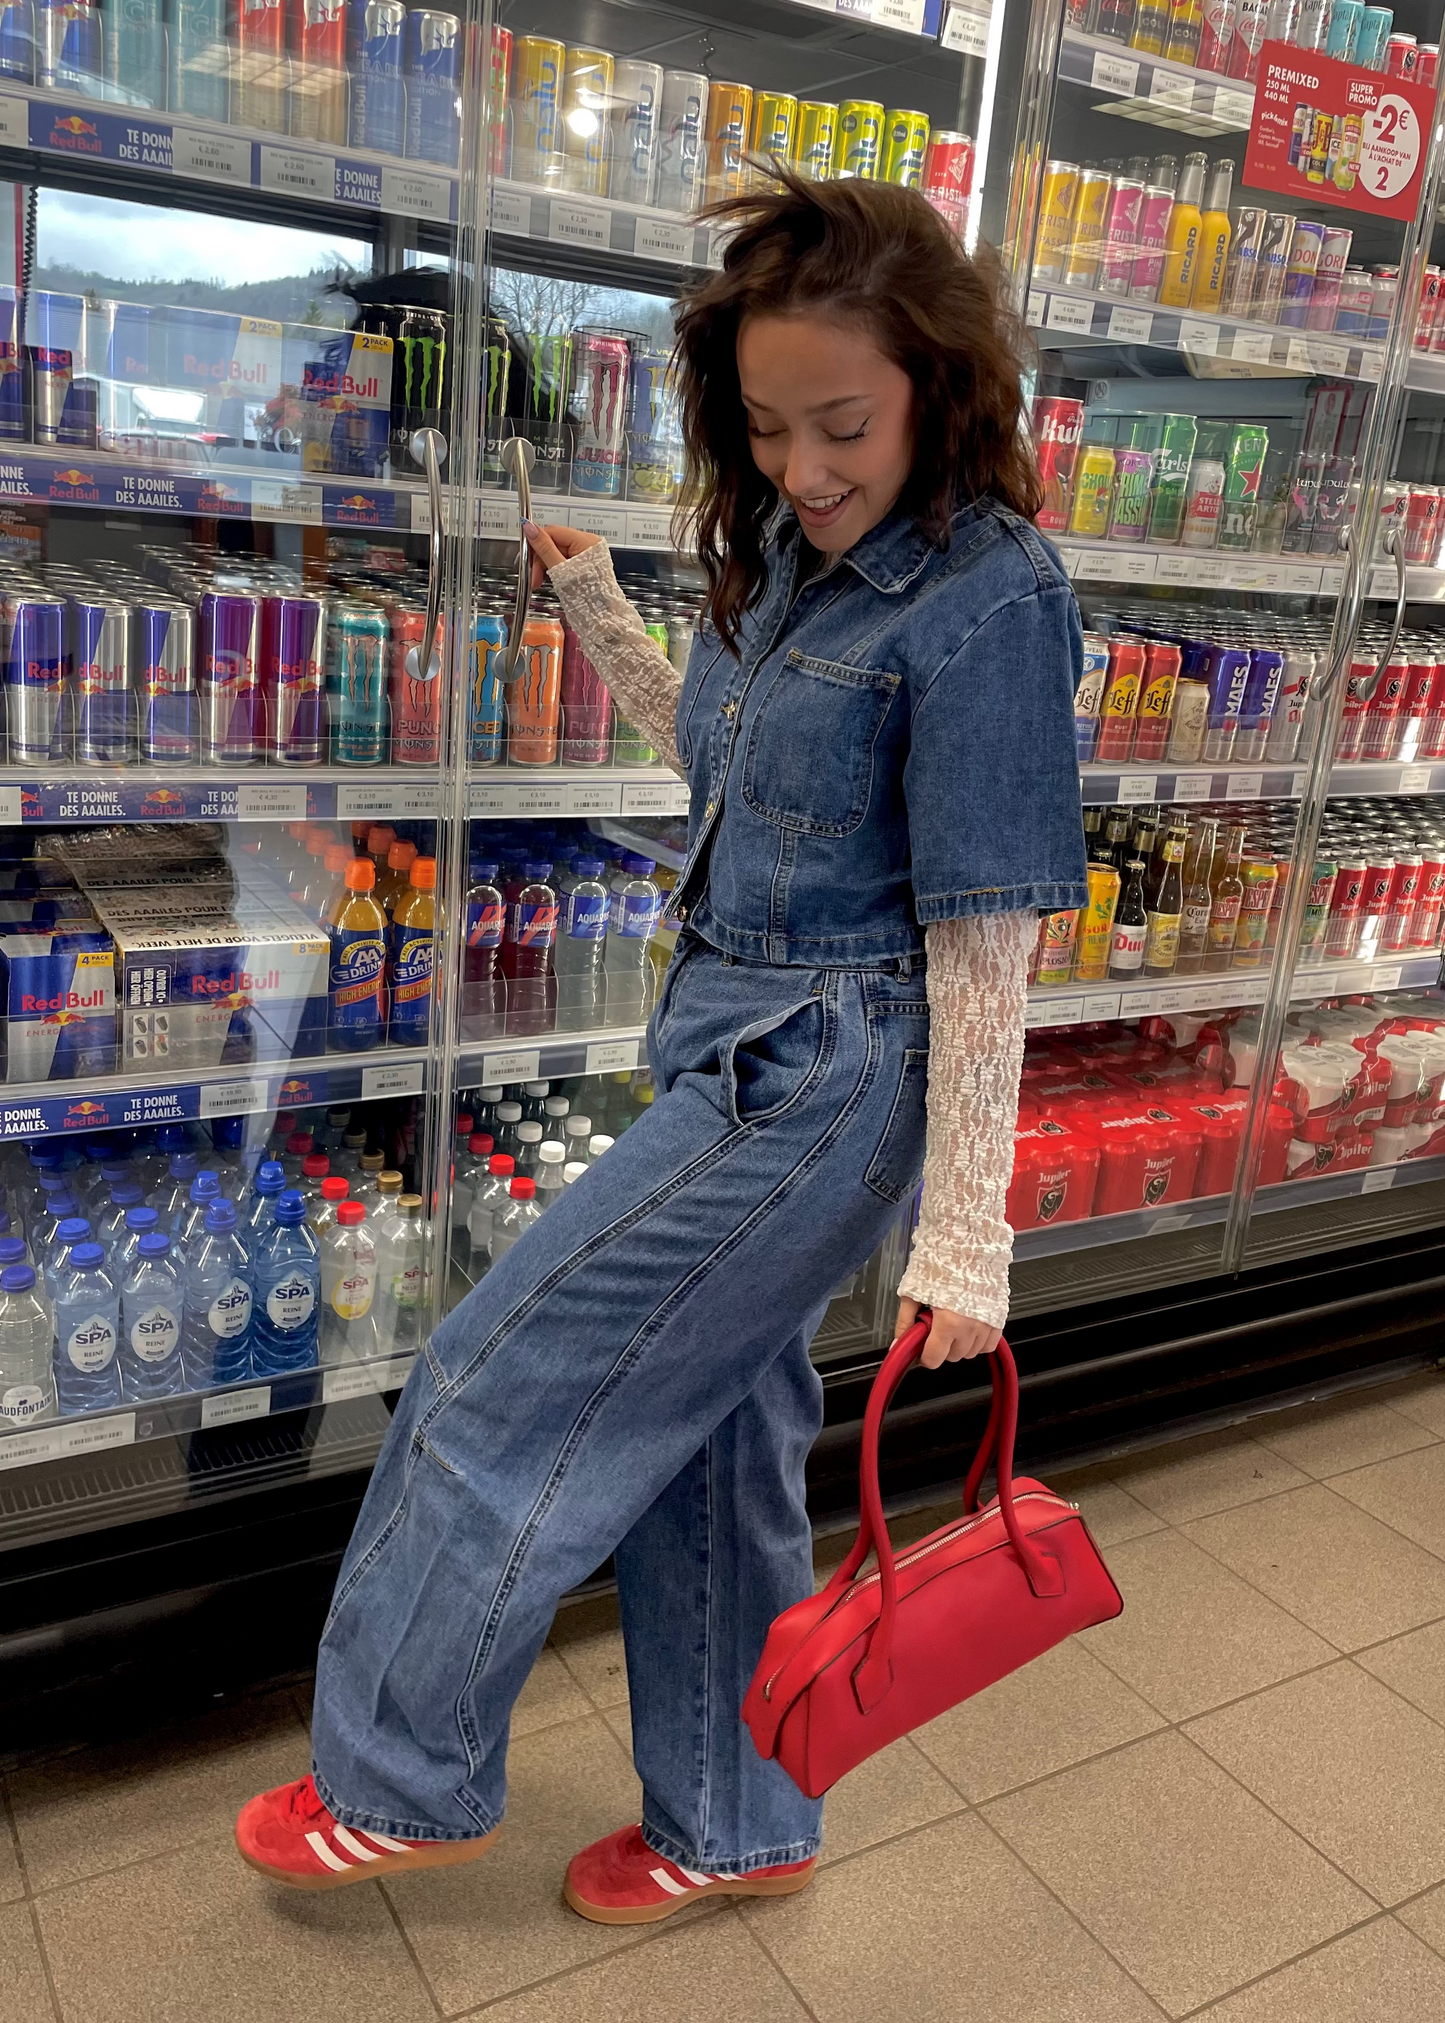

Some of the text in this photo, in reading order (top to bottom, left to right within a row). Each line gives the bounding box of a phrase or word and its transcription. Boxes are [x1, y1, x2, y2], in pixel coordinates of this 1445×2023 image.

[1268, 64, 1319, 89] PREMIXED
[1266, 79, 1290, 93] 250 ML
[1351, 82, 1374, 95] SUPER
[1264, 90, 1289, 104] 440 ML
[1349, 93, 1378, 106] PROMO
[50, 132, 102, 154] Red Bull
[127, 129, 140, 143] TE
[142, 131, 173, 148] DONN
[119, 144, 173, 166] DES AAAIL
[205, 146, 219, 156] 2,60
[1362, 142, 1411, 161] BIJ AANKOOP VAN
[290, 163, 305, 172] 2,60
[1349, 163, 1361, 171] NEW
[1394, 159, 1402, 167] DE
[344, 169, 378, 188] DONNE
[1375, 166, 1389, 191] 2
[410, 185, 423, 194] 2,60
[577, 216, 588, 224] 2,30
[1181, 227, 1198, 284] RICARD
[1210, 234, 1226, 290] RICARD
[249, 321, 277, 332] 2 PACK
[362, 337, 389, 348] 2 PACK
[38, 346, 70, 365] Red
[184, 354, 267, 384] Red Bull
[303, 370, 378, 398] Red Bull
[1152, 448, 1189, 475] Carls
[0, 466, 24, 480] NNE
[0, 482, 33, 496] AILES.
[123, 477, 175, 493] TE DONNE
[50, 486, 99, 501] Red Bull
[116, 491, 183, 508] DES AAAILES.
[198, 498, 244, 513] Red Bull
[337, 510, 379, 524] Red Bull
[28, 661, 67, 679] Red
[206, 654, 240, 676] Red
[273, 656, 304, 676] Red
[90, 665, 123, 682] Bull
[156, 667, 187, 684] Bull
[1225, 666, 1249, 717] MAES
[1259, 667, 1282, 717] MAES
[1077, 687, 1104, 716] Leff
[1109, 688, 1138, 716] Leff
[1145, 687, 1173, 716] Leff
[67, 791, 118, 803] TE DONNE
[207, 791, 219, 802] TE
[22, 805, 43, 816] Bull
[60, 805, 126, 816] DES AAAILES.
[141, 804, 186, 816] Red Bull
[201, 804, 218, 815] DES
[107, 905, 219, 917] DES AAAILES POUR
[172, 938, 201, 947] HELE
[224, 935, 261, 944] VOOR
[263, 932, 319, 942] VLEUGELS
[299, 942, 325, 953] 8 PACK
[82, 955, 90, 965] 4
[355, 949, 380, 967] AA
[131, 971, 141, 984] HIER
[192, 970, 279, 994] Red Bull
[144, 968, 154, 1002] HIER OPENEN
[340, 989, 355, 1002] HIGH
[398, 987, 415, 1000] HIGH
[22, 990, 104, 1012] Red Bull
[27, 1028, 60, 1037] ENERG
[131, 1095, 178, 1109] TE DONNE
[273, 1092, 313, 1105] Red Bull
[5, 1108, 41, 1121] DONNE
[64, 1114, 109, 1129] Red Bull
[124, 1107, 185, 1123] DES AAAILES.
[5, 1120, 49, 1134] AAAILES.
[1101, 1115, 1154, 1129] Jupiler
[1144, 1157, 1175, 1171] Jupiler
[1037, 1169, 1072, 1184] Jupiler
[343, 1278, 369, 1289] SPA
[275, 1286, 310, 1300] SPA
[218, 1293, 250, 1310] SPA
[283, 1305, 303, 1313] REINE
[225, 1314, 243, 1323] REINE
[139, 1321, 174, 1334] SPA
[76, 1329, 112, 1344] SPA
[84, 1350, 104, 1358] REINE
